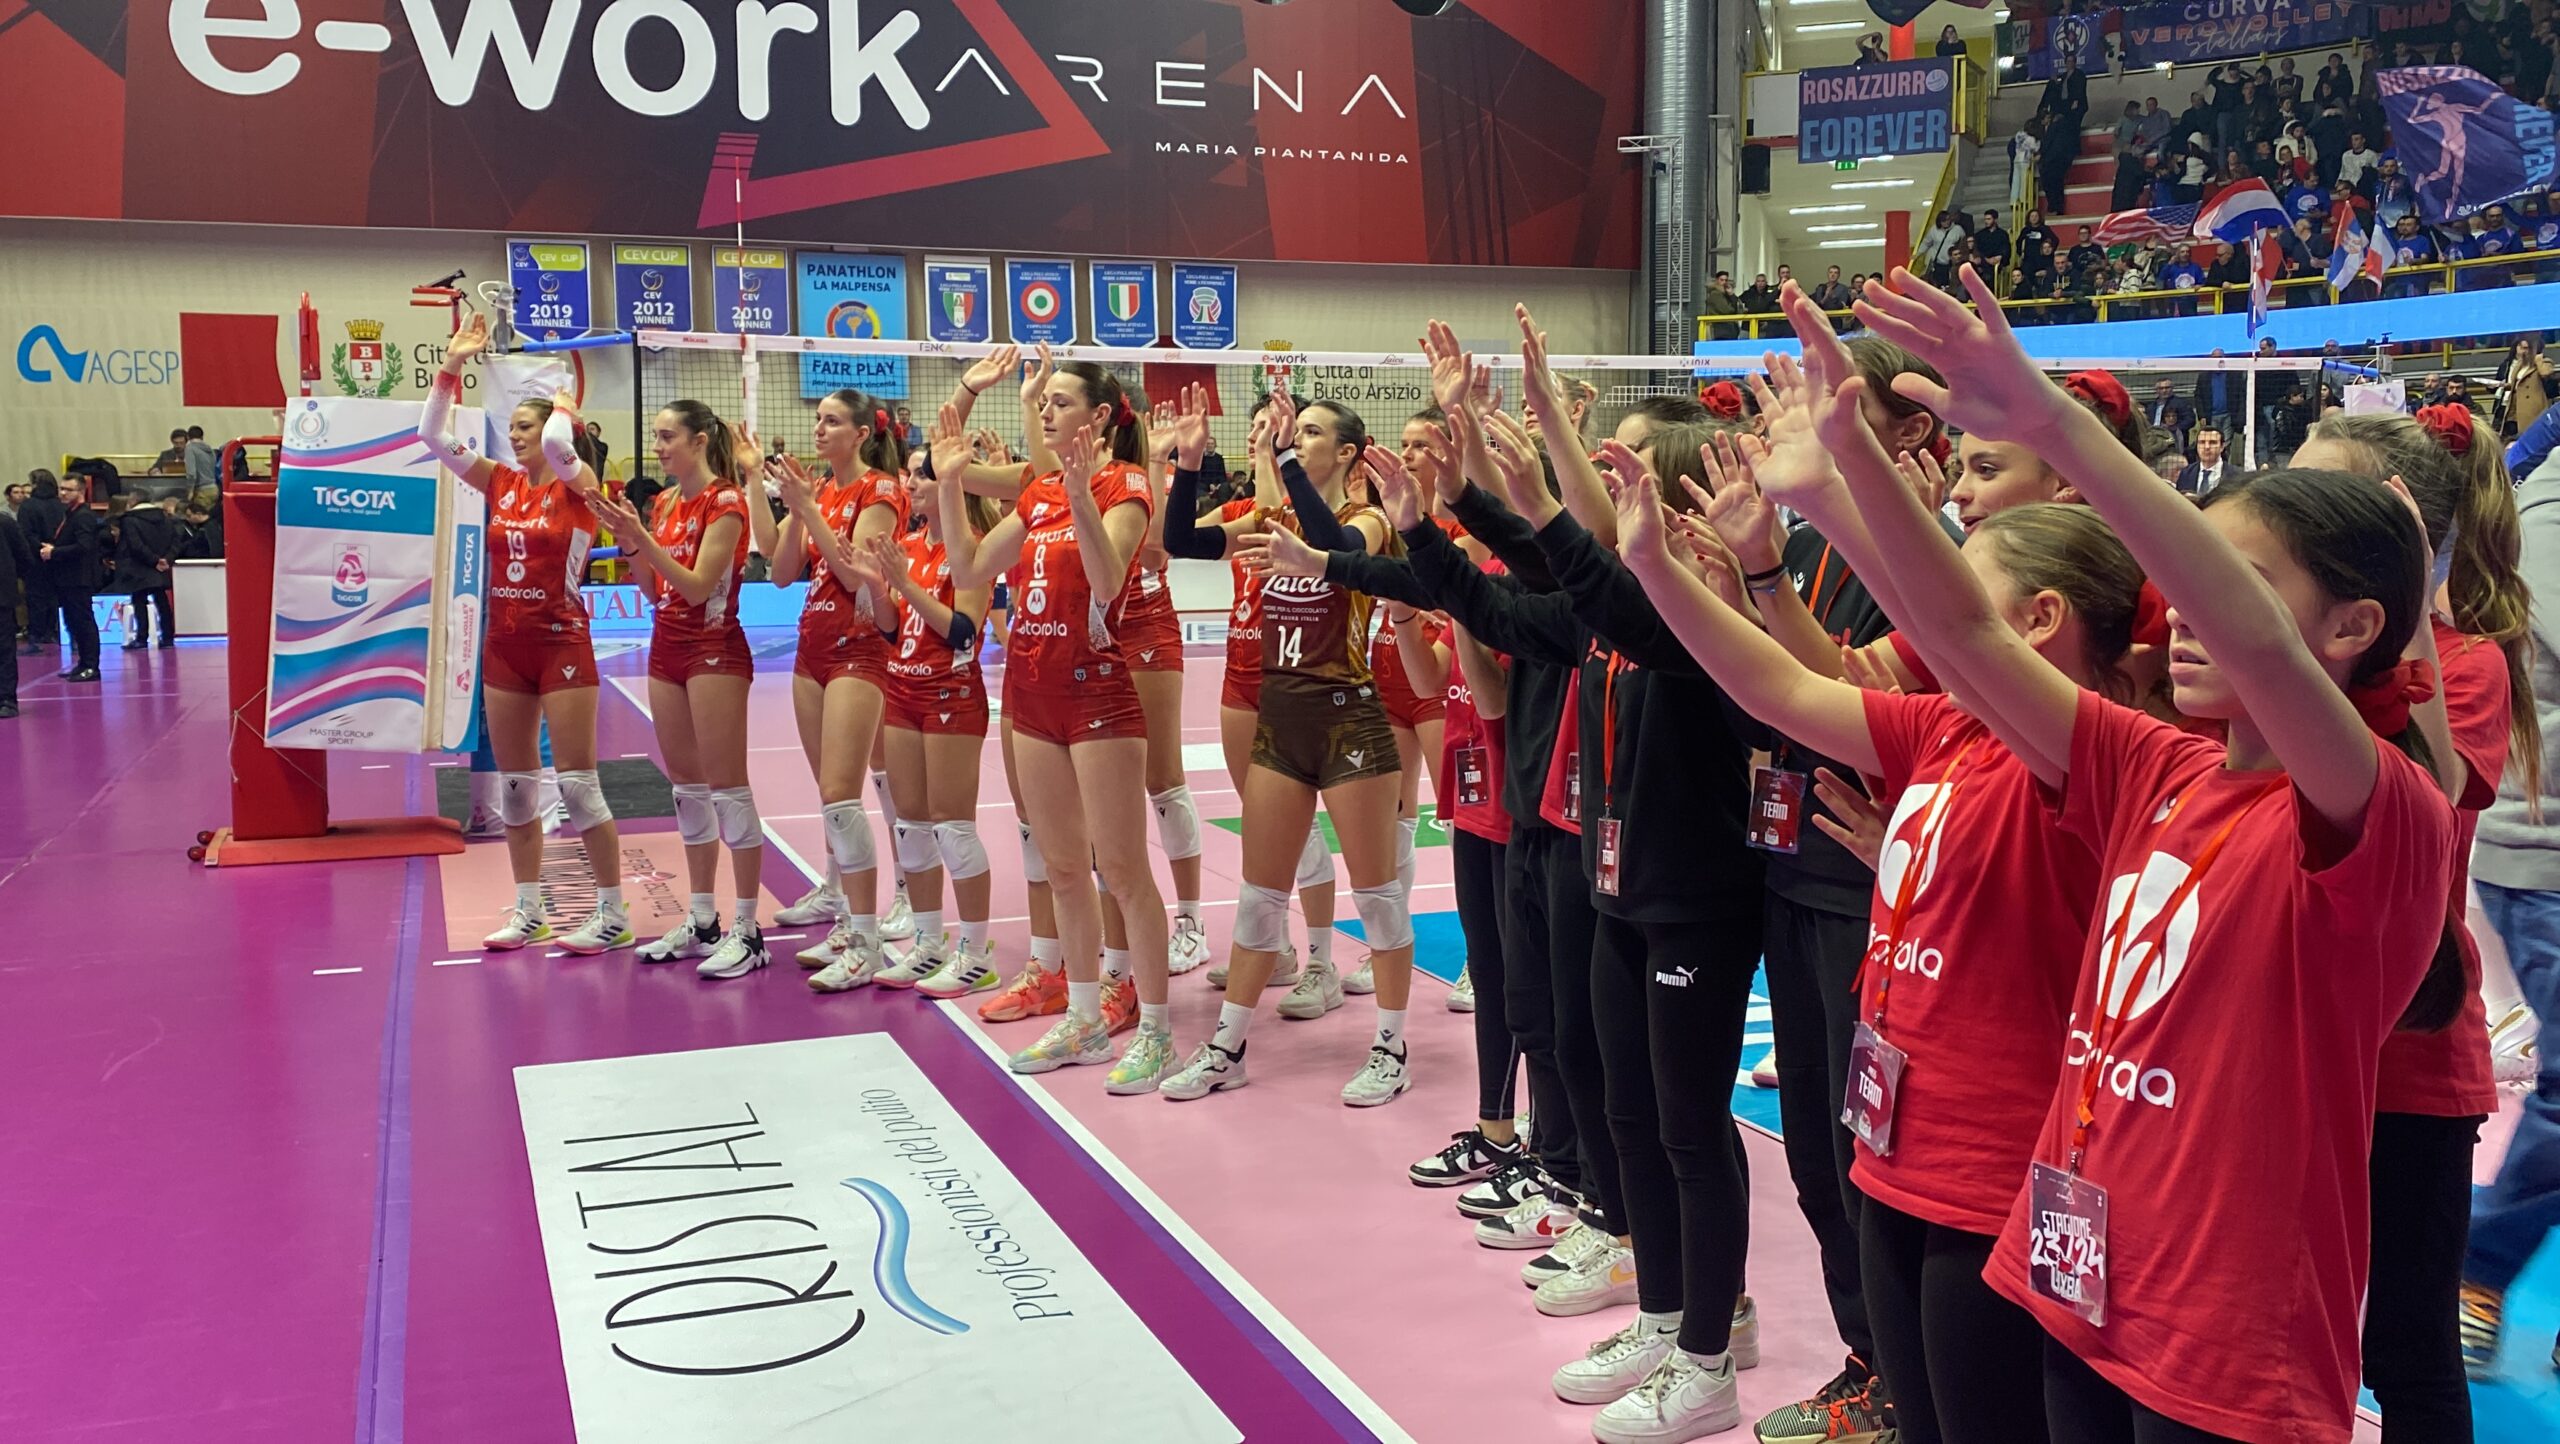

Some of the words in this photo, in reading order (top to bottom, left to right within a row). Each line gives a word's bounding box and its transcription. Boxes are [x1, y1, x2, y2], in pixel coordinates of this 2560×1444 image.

[2183, 0, 2291, 21] CURVA
[169, 0, 931, 131] e-work
[936, 48, 1406, 119] ARENA
[1802, 109, 1948, 160] FOREVER
[1155, 140, 1238, 156] MARIA
[1254, 146, 1409, 164] PIANTANIDA
[539, 253, 557, 263] CEV
[561, 253, 579, 264] CUP
[623, 249, 650, 262] CEV
[651, 250, 679, 262] CUP
[722, 252, 748, 264] CEV
[750, 253, 777, 265] CUP
[807, 263, 897, 280] PANATHLON
[813, 280, 828, 291] LA
[831, 280, 891, 293] MALPENSA
[541, 293, 559, 302] CEV
[643, 291, 662, 300] CEV
[742, 293, 760, 302] CEV
[529, 303, 573, 319] 2019
[632, 301, 675, 316] 2012
[731, 306, 773, 321] 2010
[531, 318, 572, 328] WINNER
[634, 315, 674, 326] WINNER
[733, 319, 772, 330] WINNER
[87, 349, 179, 385] AGESP
[1262, 353, 1307, 364] e-work
[812, 360, 851, 376] FAIR
[856, 361, 895, 376] PLAY
[1314, 382, 1361, 400] Busto
[1365, 382, 1421, 401] Arsizio
[492, 514, 549, 529] e-work
[505, 529, 527, 560] 19
[1033, 544, 1047, 580] 8
[491, 586, 546, 600] motorola
[903, 604, 925, 636] 20
[1278, 624, 1303, 668] 14
[309, 728, 343, 738] MASTER
[344, 730, 374, 740] GROUP
[328, 736, 354, 746] SPORT
[1763, 801, 1788, 820] TEAM
[1655, 970, 1688, 987] PUMA
[1859, 1070, 1883, 1111] TEAM
[860, 1088, 937, 1133] pulito
[883, 1136, 948, 1164] del
[2041, 1210, 2092, 1239] STAGIONE
[564, 1101, 865, 1376] CRISTAL
[909, 1168, 1074, 1322] Professionisti
